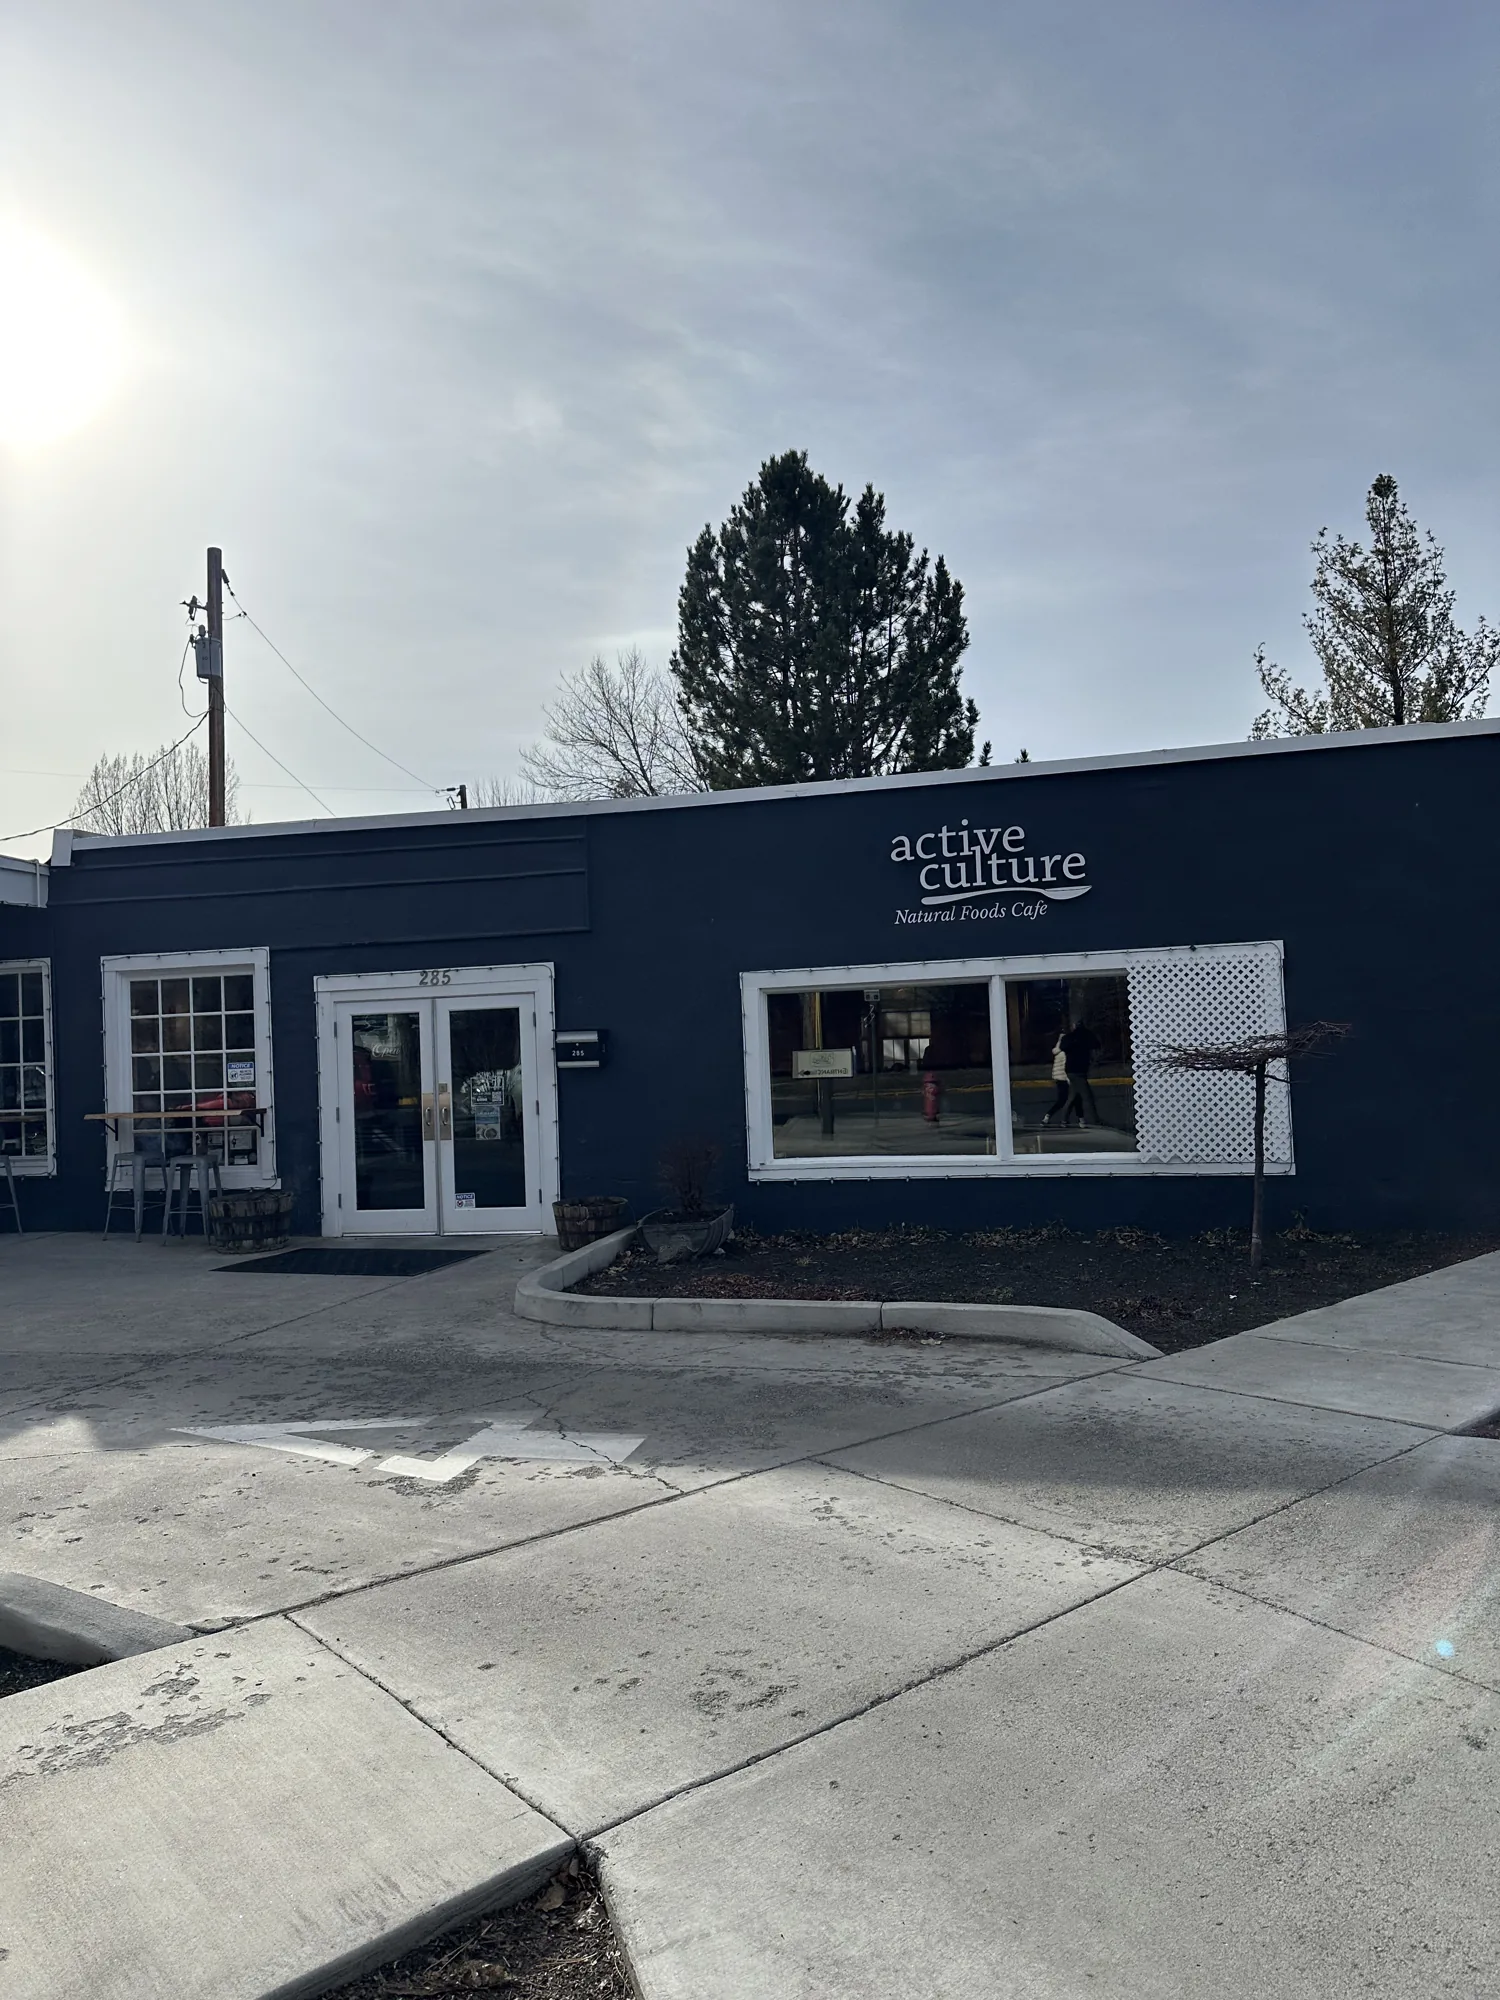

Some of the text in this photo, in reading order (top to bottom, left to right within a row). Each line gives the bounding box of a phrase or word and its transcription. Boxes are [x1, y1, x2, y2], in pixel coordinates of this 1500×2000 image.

[890, 819, 1025, 861] active
[919, 845, 1086, 889] culture
[894, 900, 1048, 925] Natural Foods Cafe
[419, 970, 451, 986] 285
